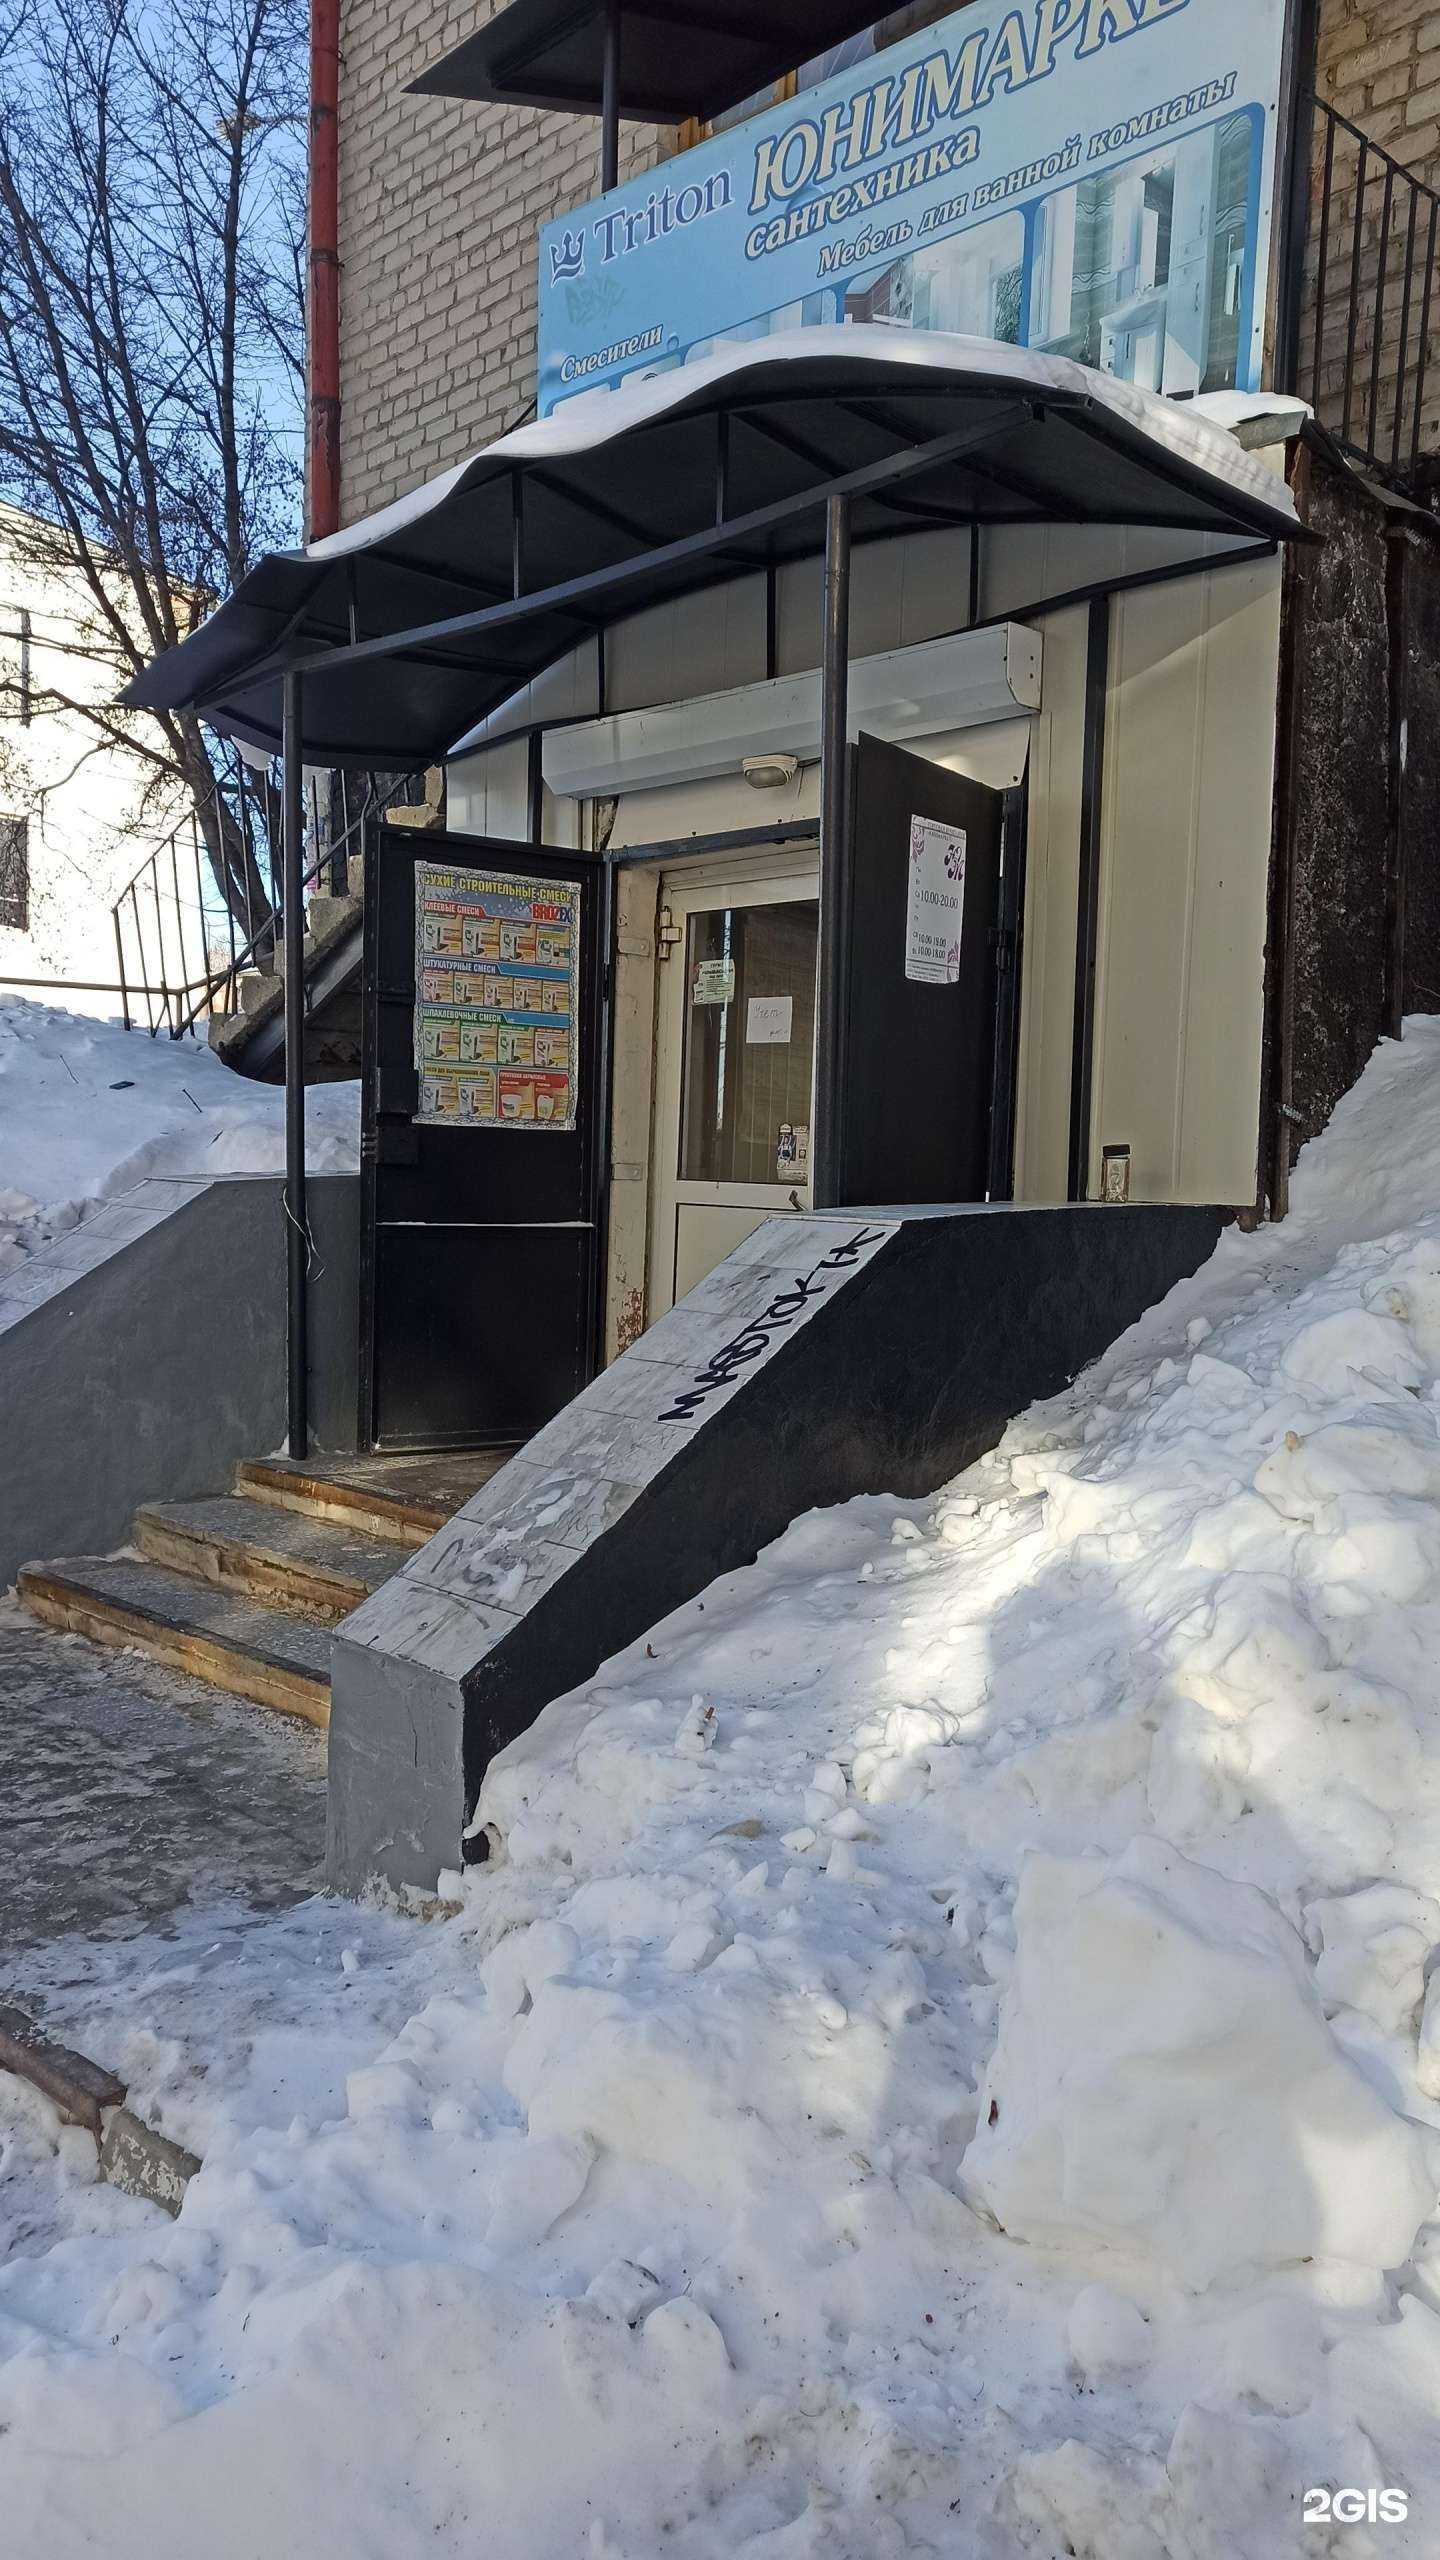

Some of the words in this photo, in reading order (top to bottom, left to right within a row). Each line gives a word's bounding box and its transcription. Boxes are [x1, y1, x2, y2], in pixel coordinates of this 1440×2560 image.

[745, 125, 981, 261] сантехника
[817, 224, 913, 278] Мебель
[917, 193, 969, 237] для
[972, 134, 1083, 210] ванной
[1087, 70, 1239, 161] комнаты
[593, 169, 735, 264] Triton
[560, 323, 664, 384] Смесители
[424, 872, 456, 888] СУХИЕ
[459, 876, 537, 899] СТРОИТЕЛЬНЫЕ
[424, 901, 456, 913] КЛЕЕВЫЕ
[456, 904, 481, 916] СМЕСИ
[423, 958, 472, 971] ШТУКАТУРНЫЕ
[473, 963, 497, 974] СМЕСИ
[422, 1008, 478, 1021] ШПАКЛЕВОЧНЫЕ
